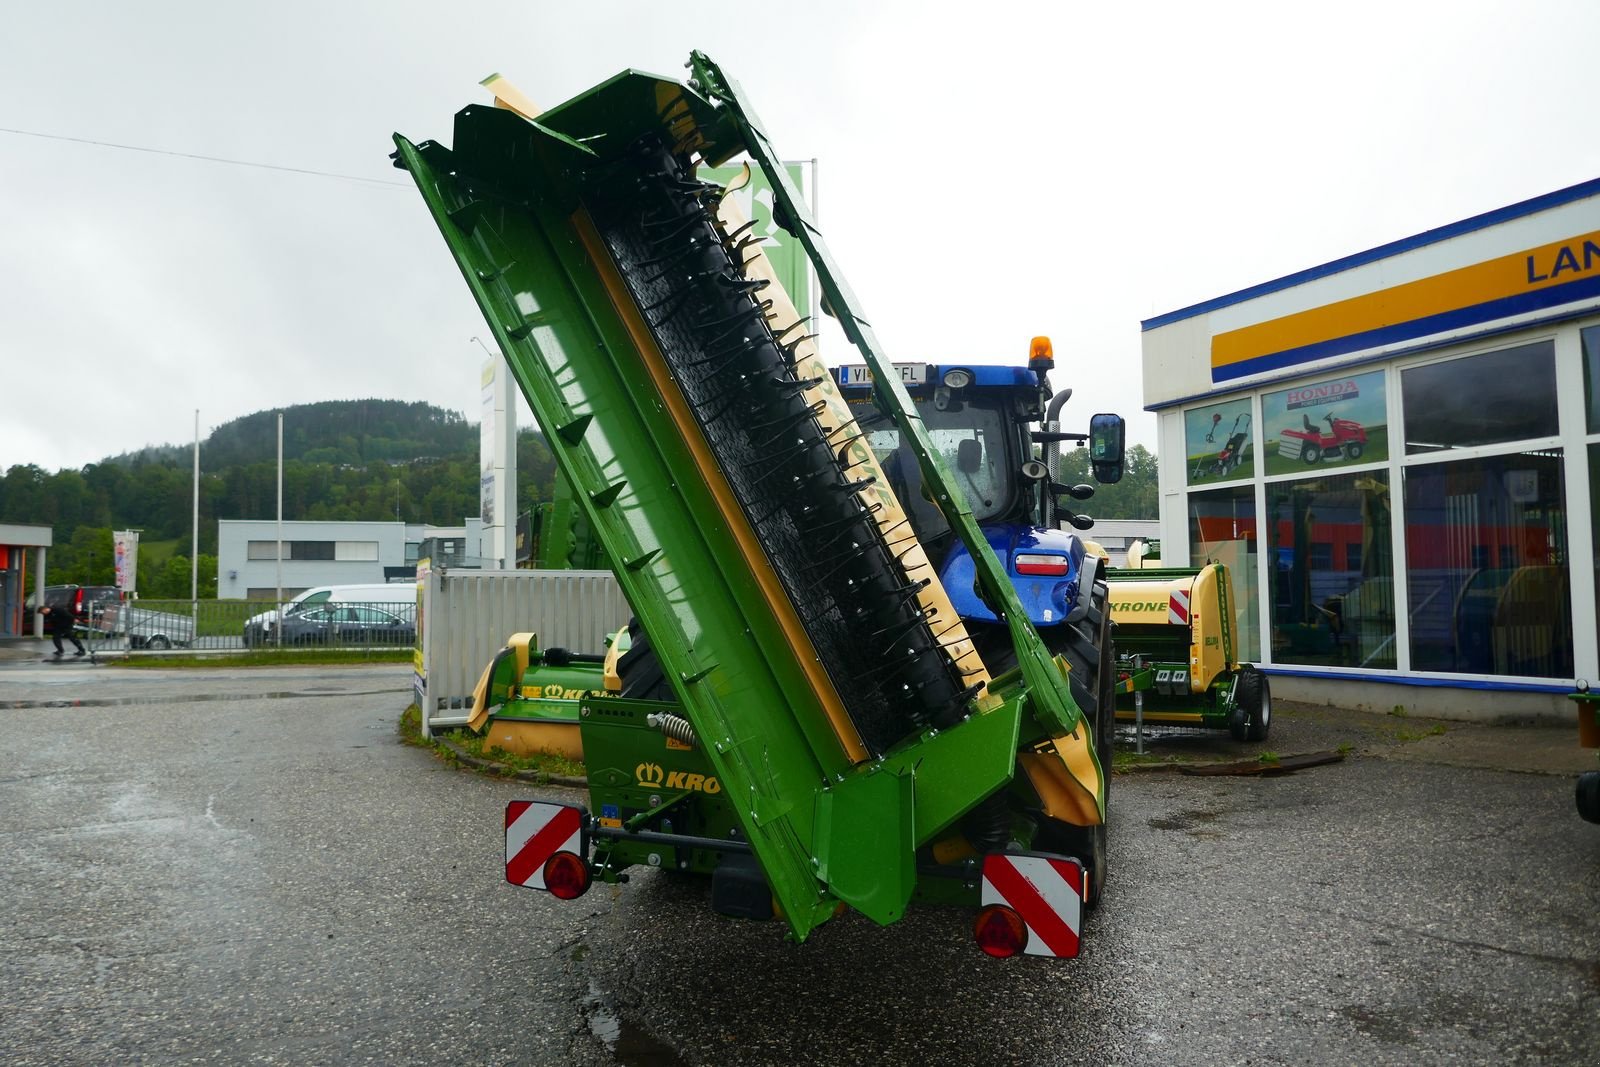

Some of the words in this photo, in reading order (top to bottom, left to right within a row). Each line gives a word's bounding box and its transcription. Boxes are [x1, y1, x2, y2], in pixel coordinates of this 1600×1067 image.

[854, 368, 866, 382] VI
[1287, 380, 1358, 405] HONDA
[1109, 602, 1169, 612] KRONE
[665, 771, 721, 794] KRO
